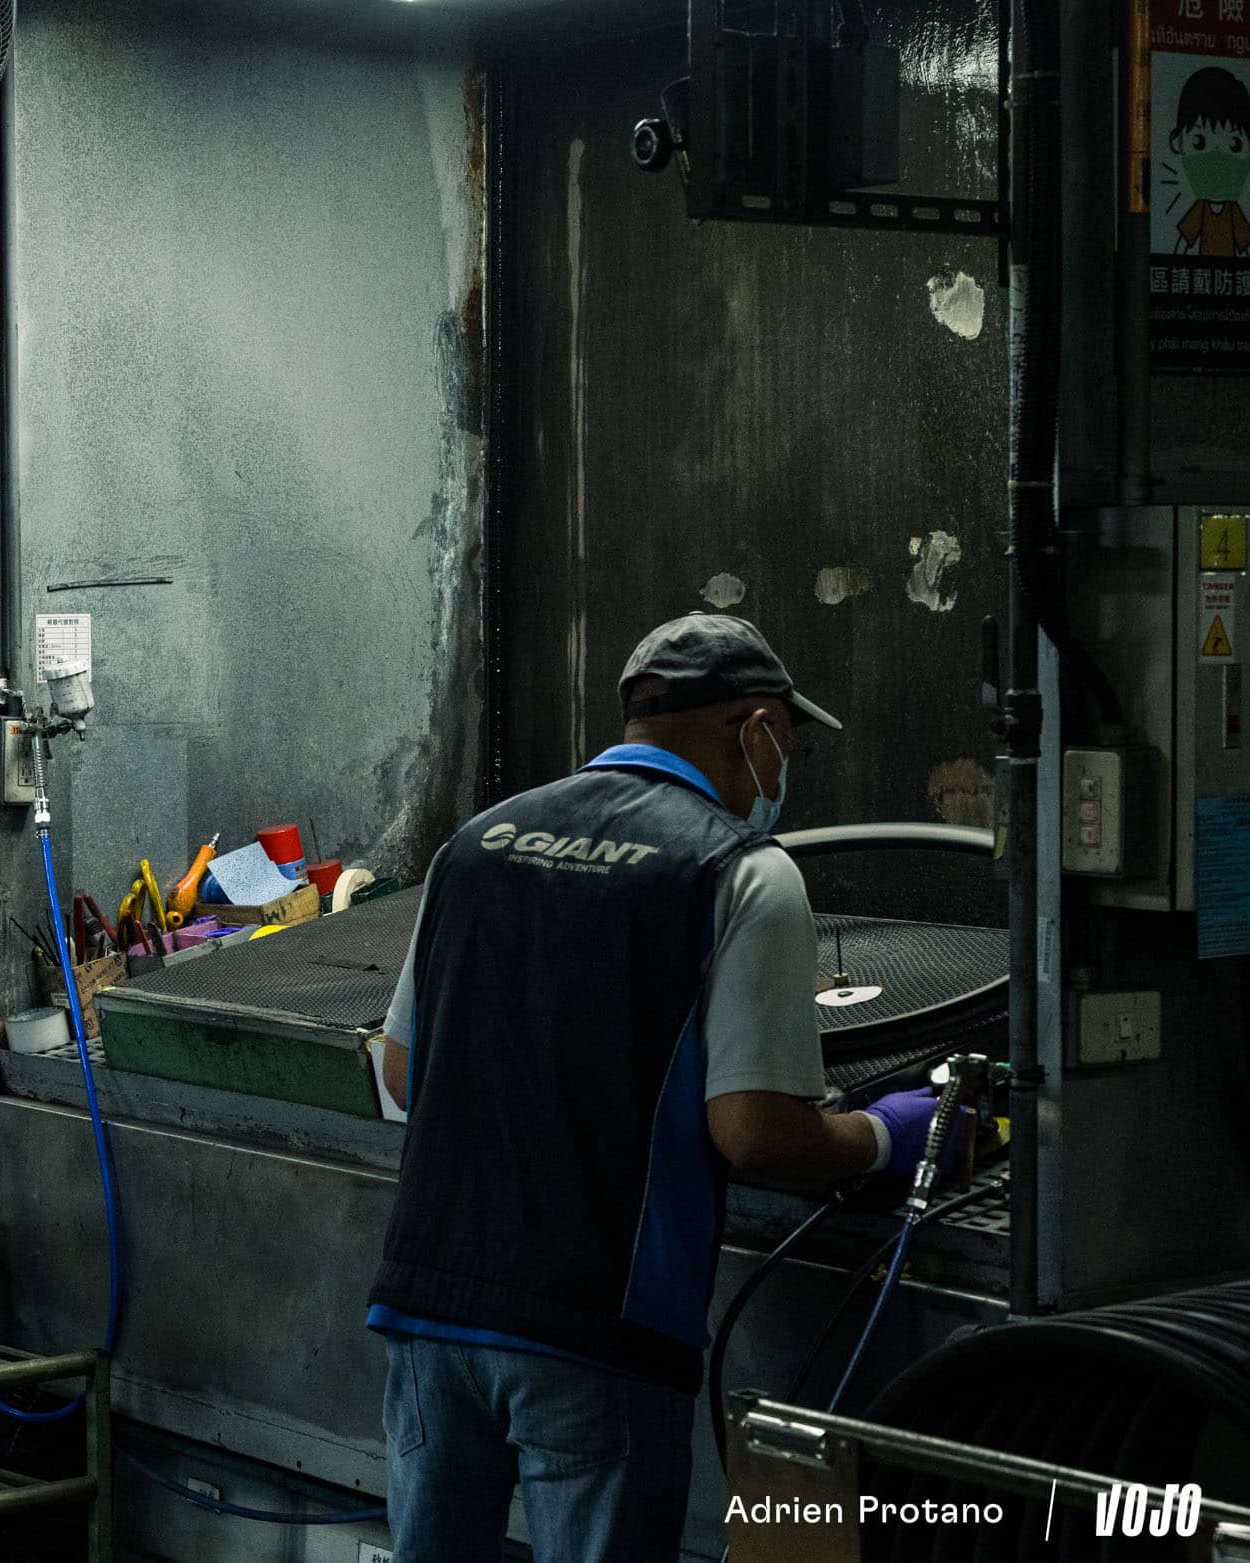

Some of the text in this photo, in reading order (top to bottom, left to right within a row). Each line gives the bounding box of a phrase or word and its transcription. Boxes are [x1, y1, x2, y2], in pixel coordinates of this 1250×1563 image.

[1216, 527, 1231, 561] 4
[513, 831, 661, 864] GIANT
[507, 854, 612, 875] INSPIRING ADVENTURE
